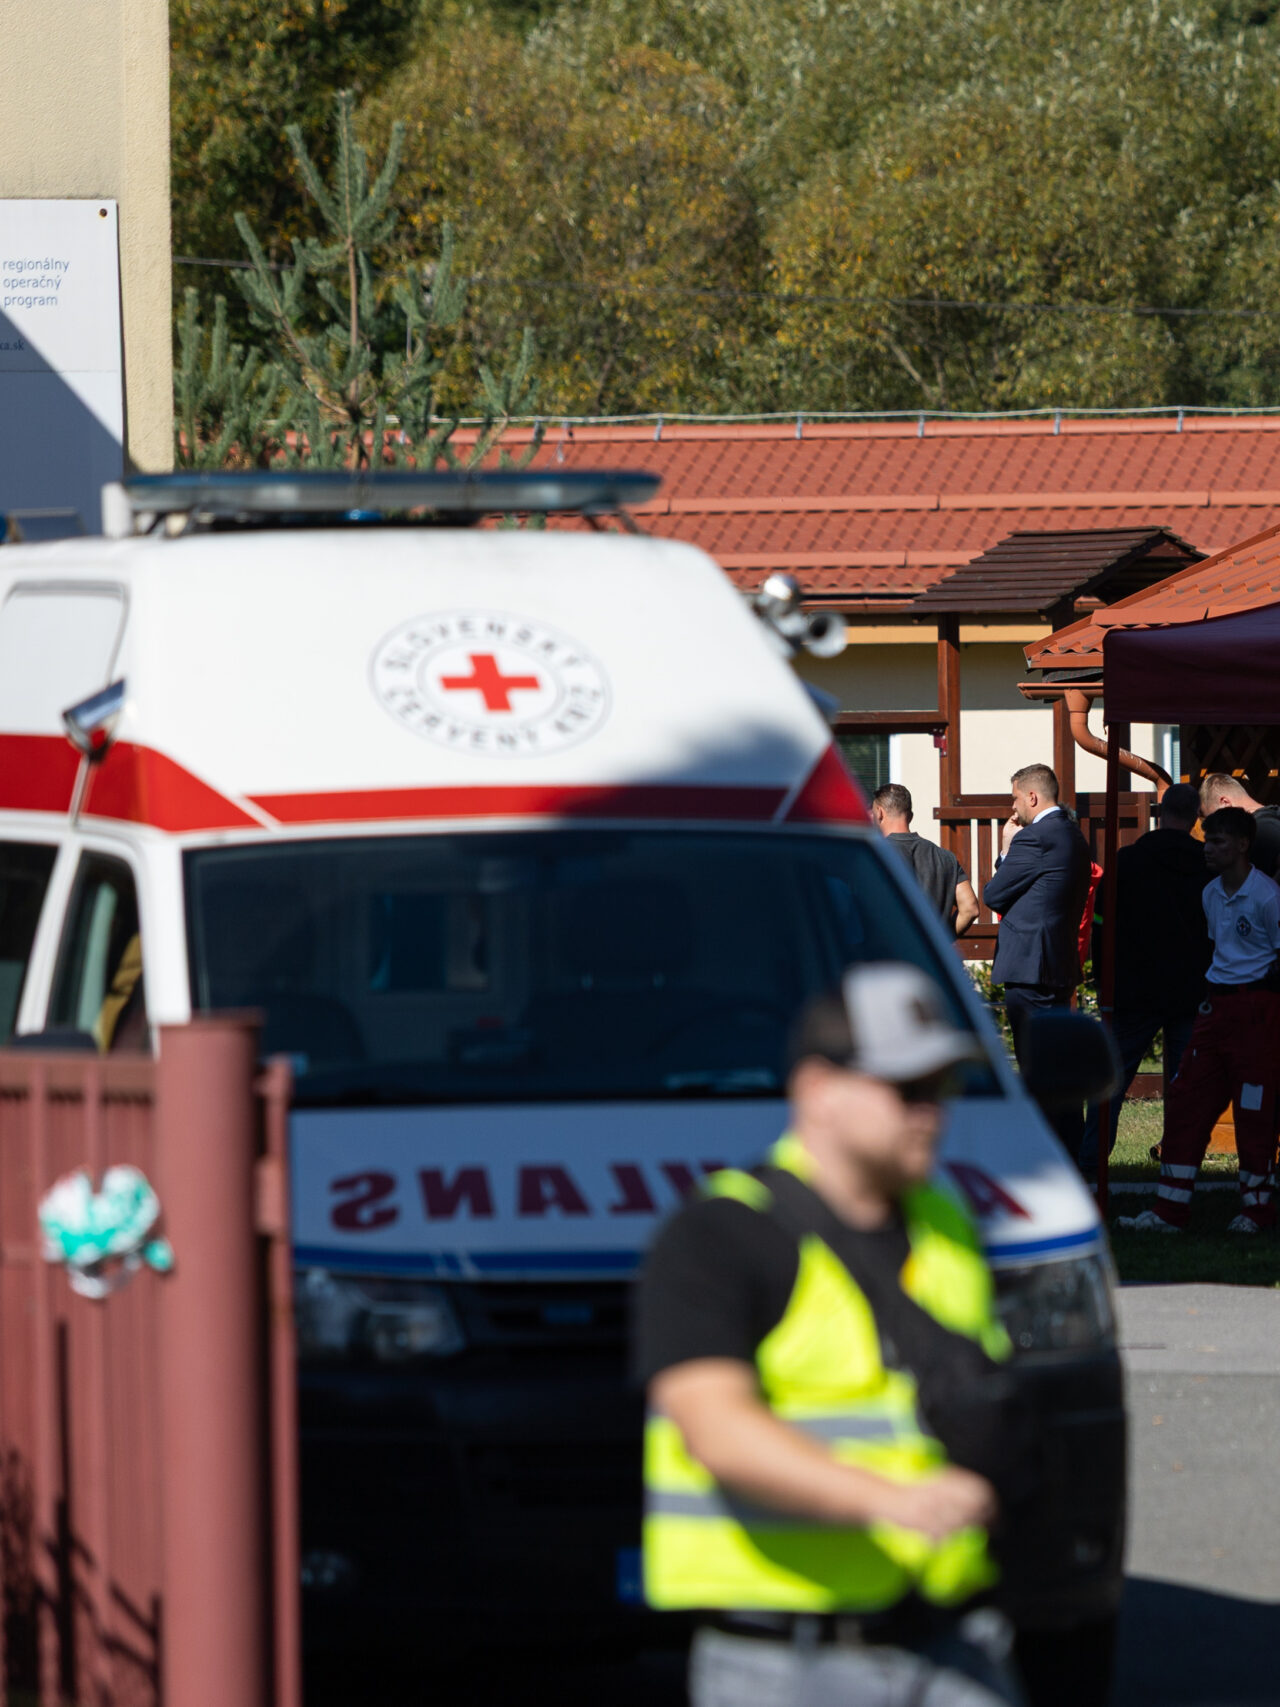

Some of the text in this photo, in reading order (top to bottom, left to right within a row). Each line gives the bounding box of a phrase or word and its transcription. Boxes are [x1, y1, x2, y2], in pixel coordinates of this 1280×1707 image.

[3, 257, 70, 272] regionálny
[3, 275, 62, 290] operačný
[4, 296, 58, 309] program
